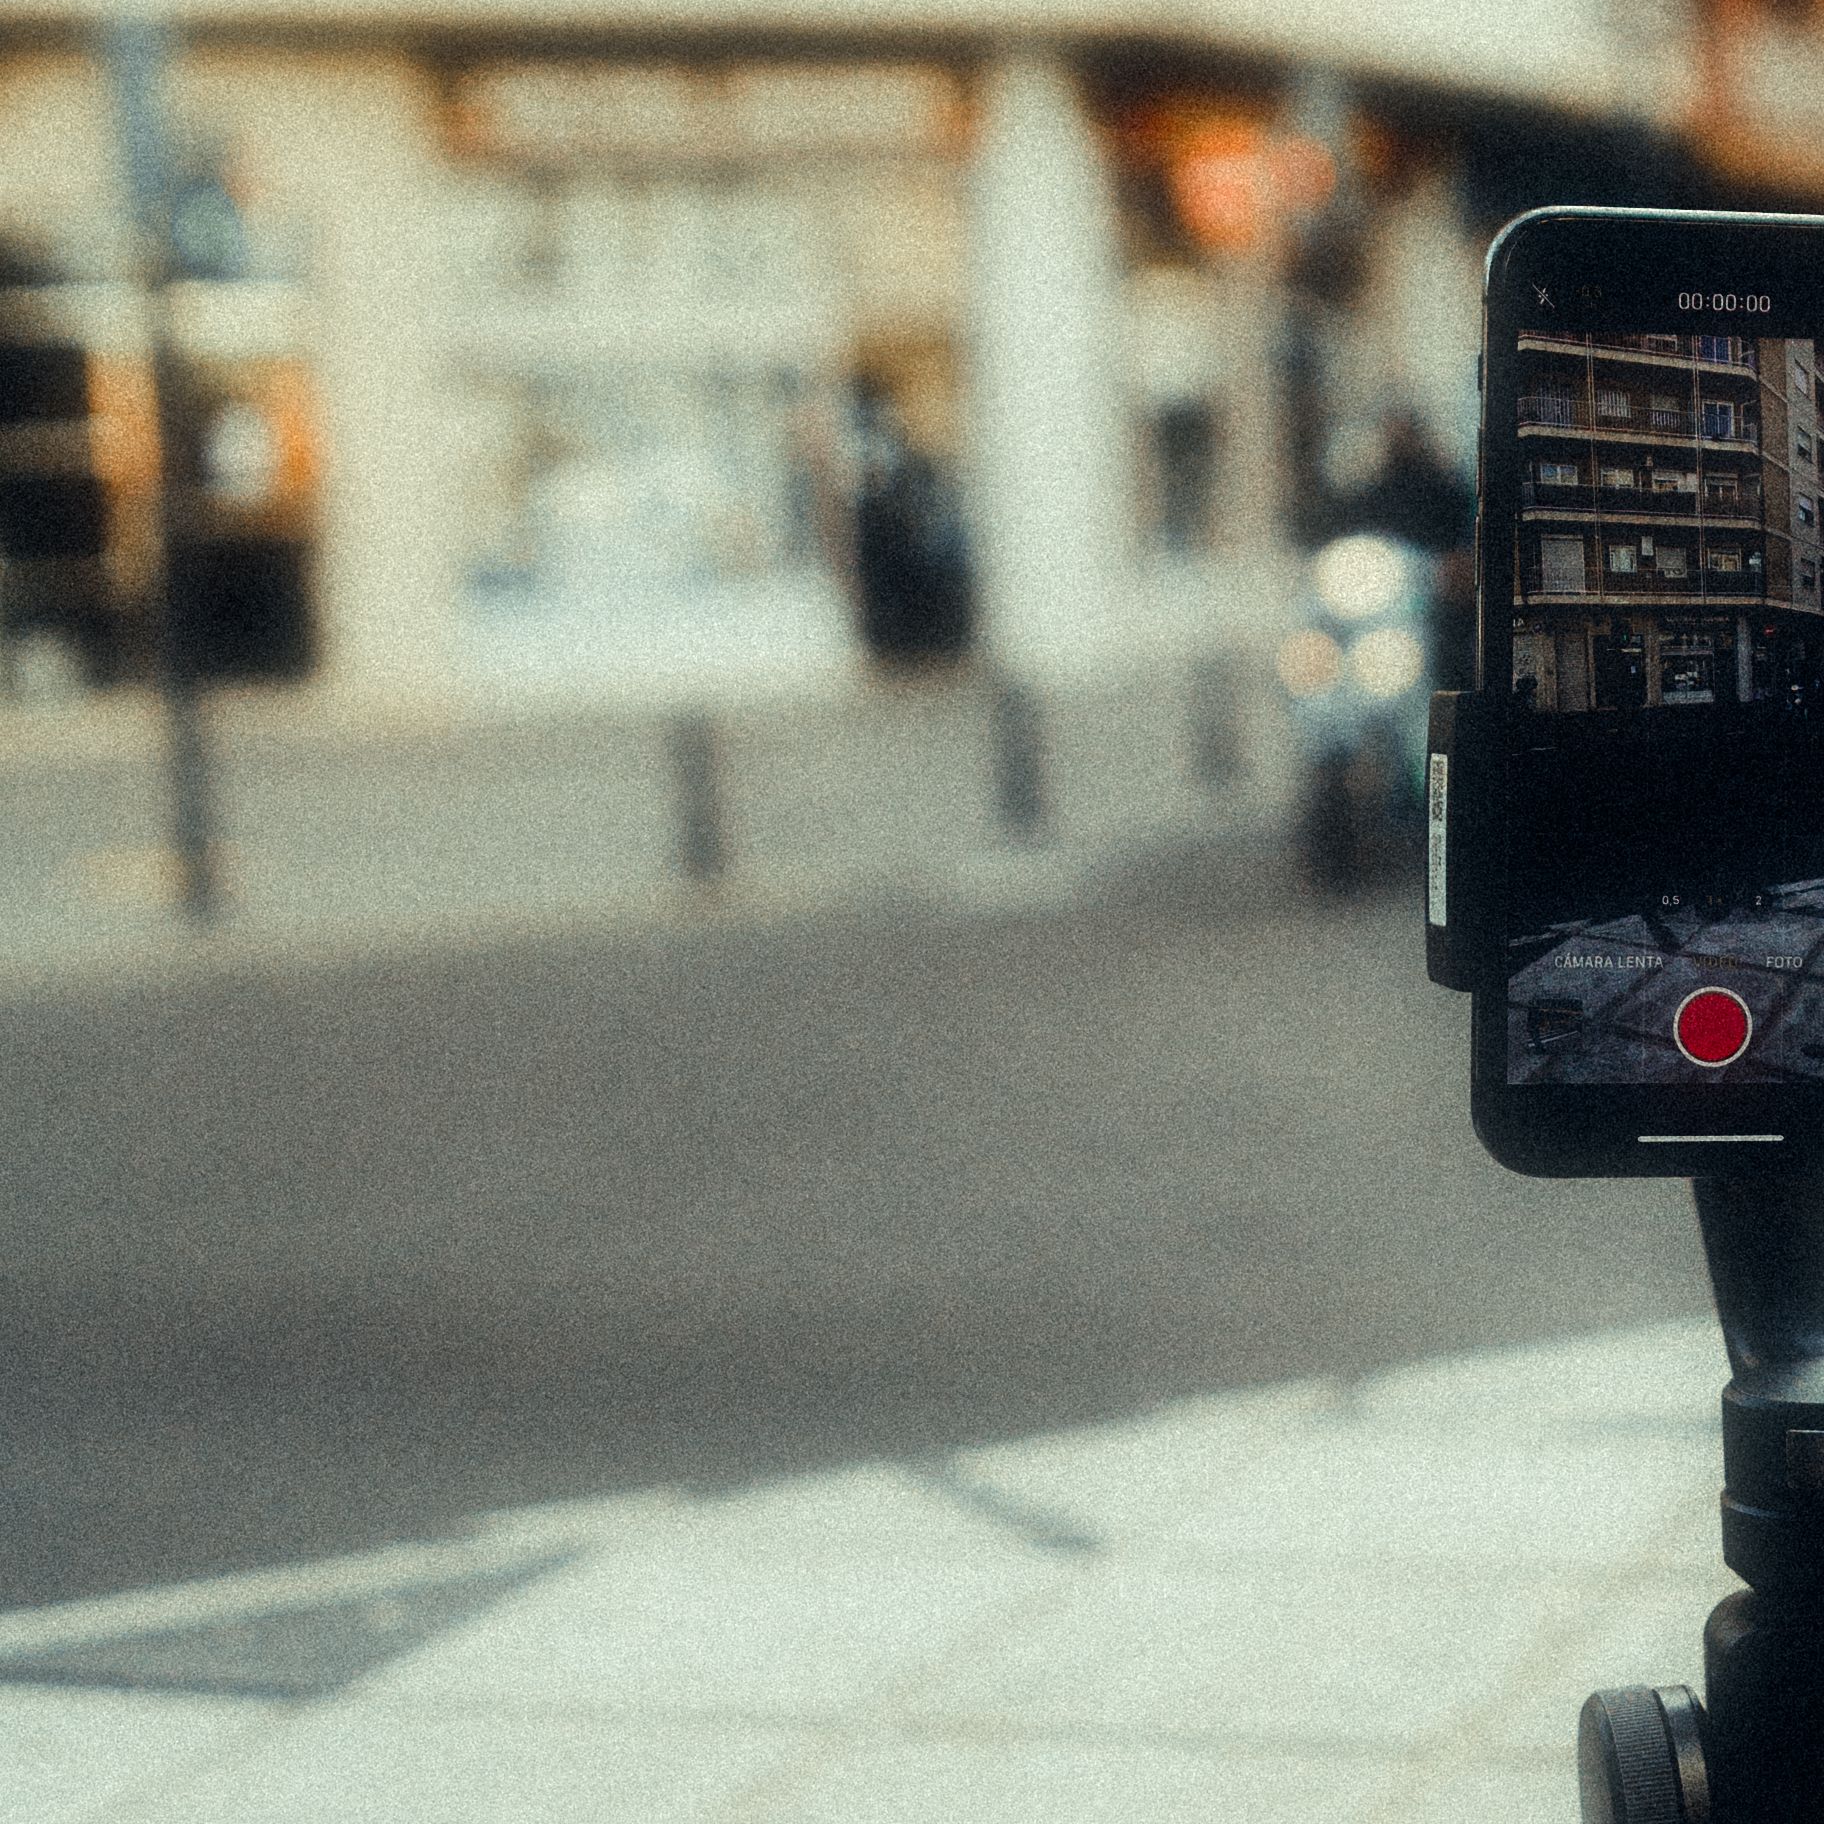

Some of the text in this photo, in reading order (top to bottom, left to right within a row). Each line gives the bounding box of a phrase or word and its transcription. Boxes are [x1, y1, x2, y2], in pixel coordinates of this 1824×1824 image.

[1678, 292, 1771, 313] 00:00:00
[1554, 952, 1614, 969] CÁMARA
[1617, 955, 1664, 969] LENTA
[1765, 956, 1803, 969] FOTO
